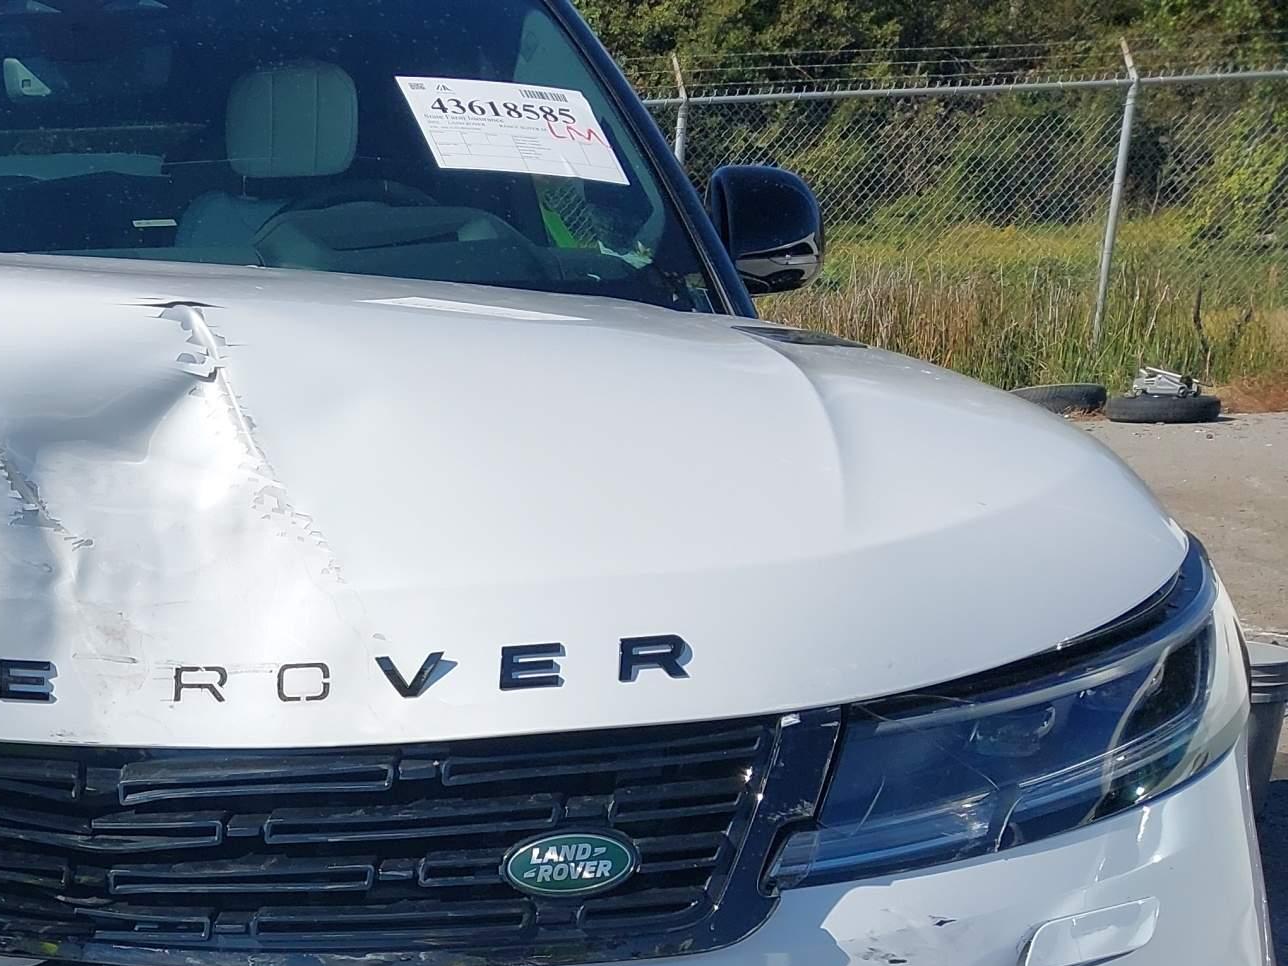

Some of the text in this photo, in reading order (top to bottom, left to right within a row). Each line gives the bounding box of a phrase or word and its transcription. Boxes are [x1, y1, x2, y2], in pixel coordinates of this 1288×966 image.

[431, 97, 576, 124] 43618585
[173, 634, 690, 702] ROVER
[530, 843, 592, 864] LAND
[536, 860, 612, 882] ROVER
